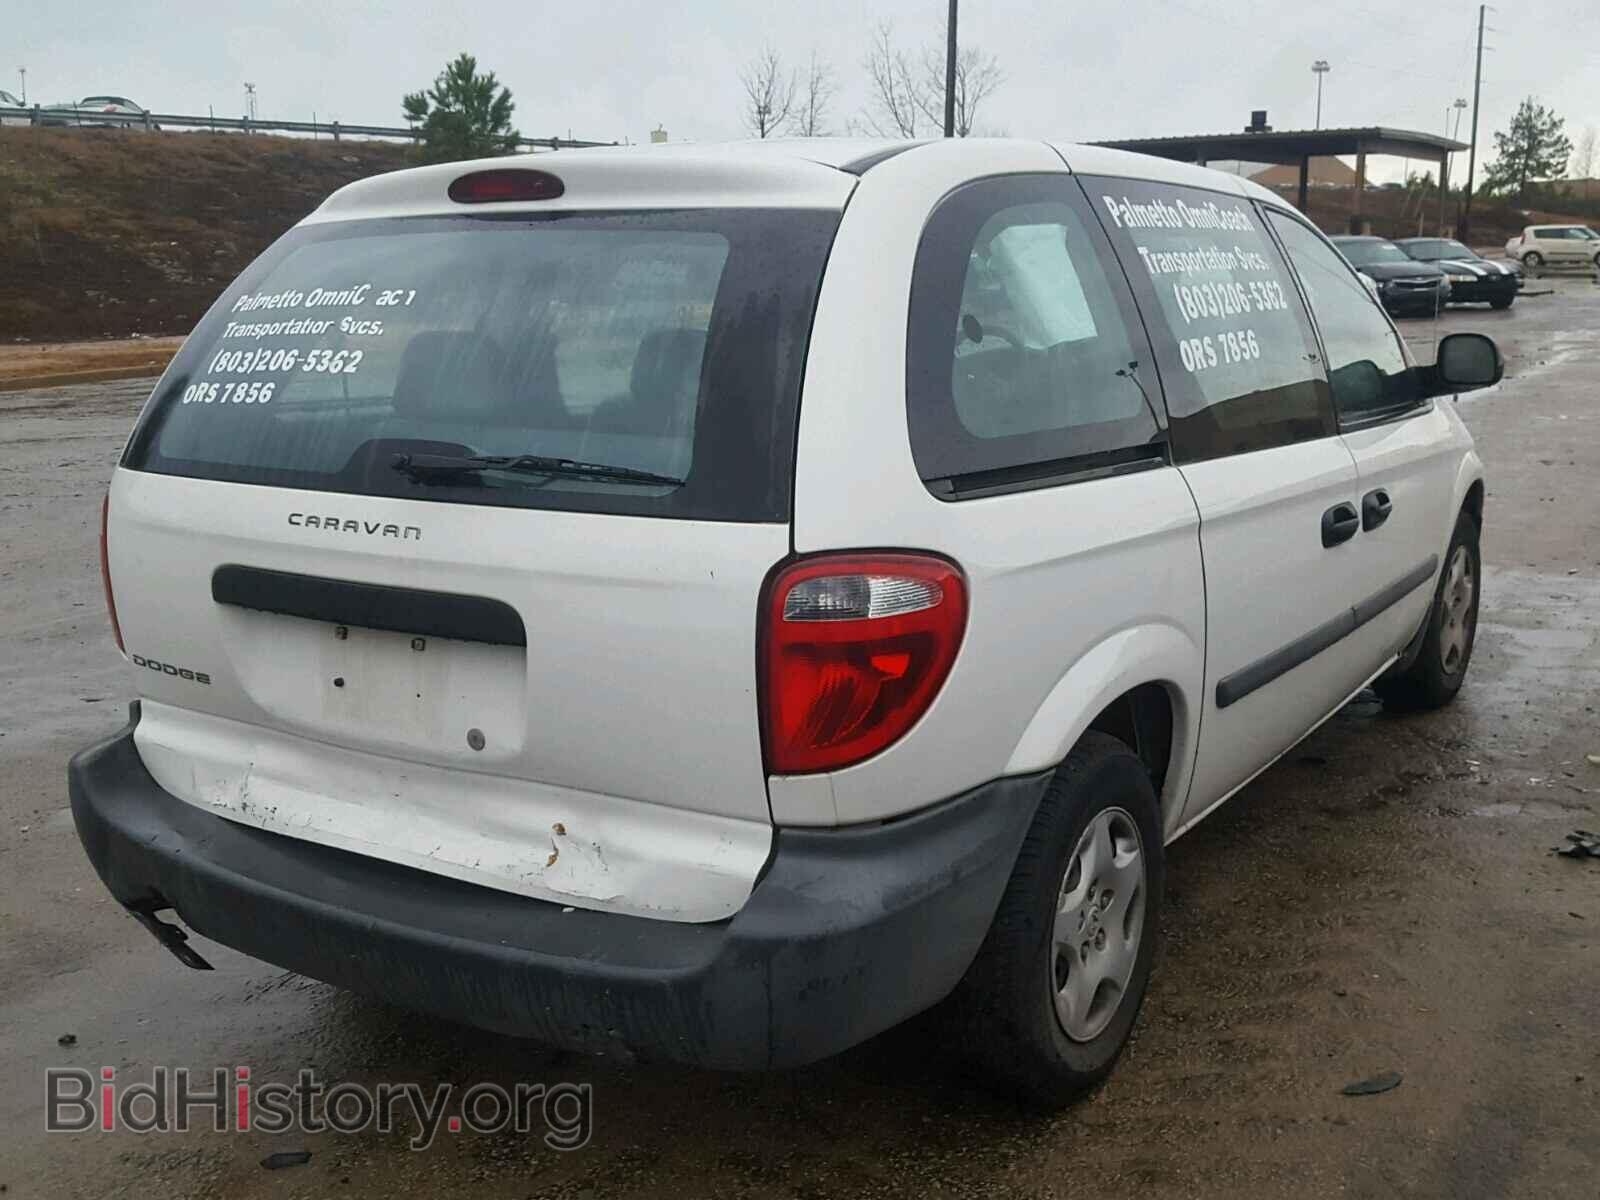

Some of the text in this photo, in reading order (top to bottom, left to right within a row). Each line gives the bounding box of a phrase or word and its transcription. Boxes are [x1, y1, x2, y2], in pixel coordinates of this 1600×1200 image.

[1102, 196, 1182, 228] Palmetto
[1138, 247, 1237, 277] Transportation
[232, 288, 303, 313] Palmetto
[1174, 280, 1287, 325] (803)206-5362
[339, 316, 384, 337] Svcs.
[208, 348, 364, 374] (803)206-5362
[1179, 329, 1260, 373] ORS 7856
[183, 382, 275, 404] ORS 7856
[288, 513, 422, 541] CARAVAN
[132, 654, 211, 685] DODGE
